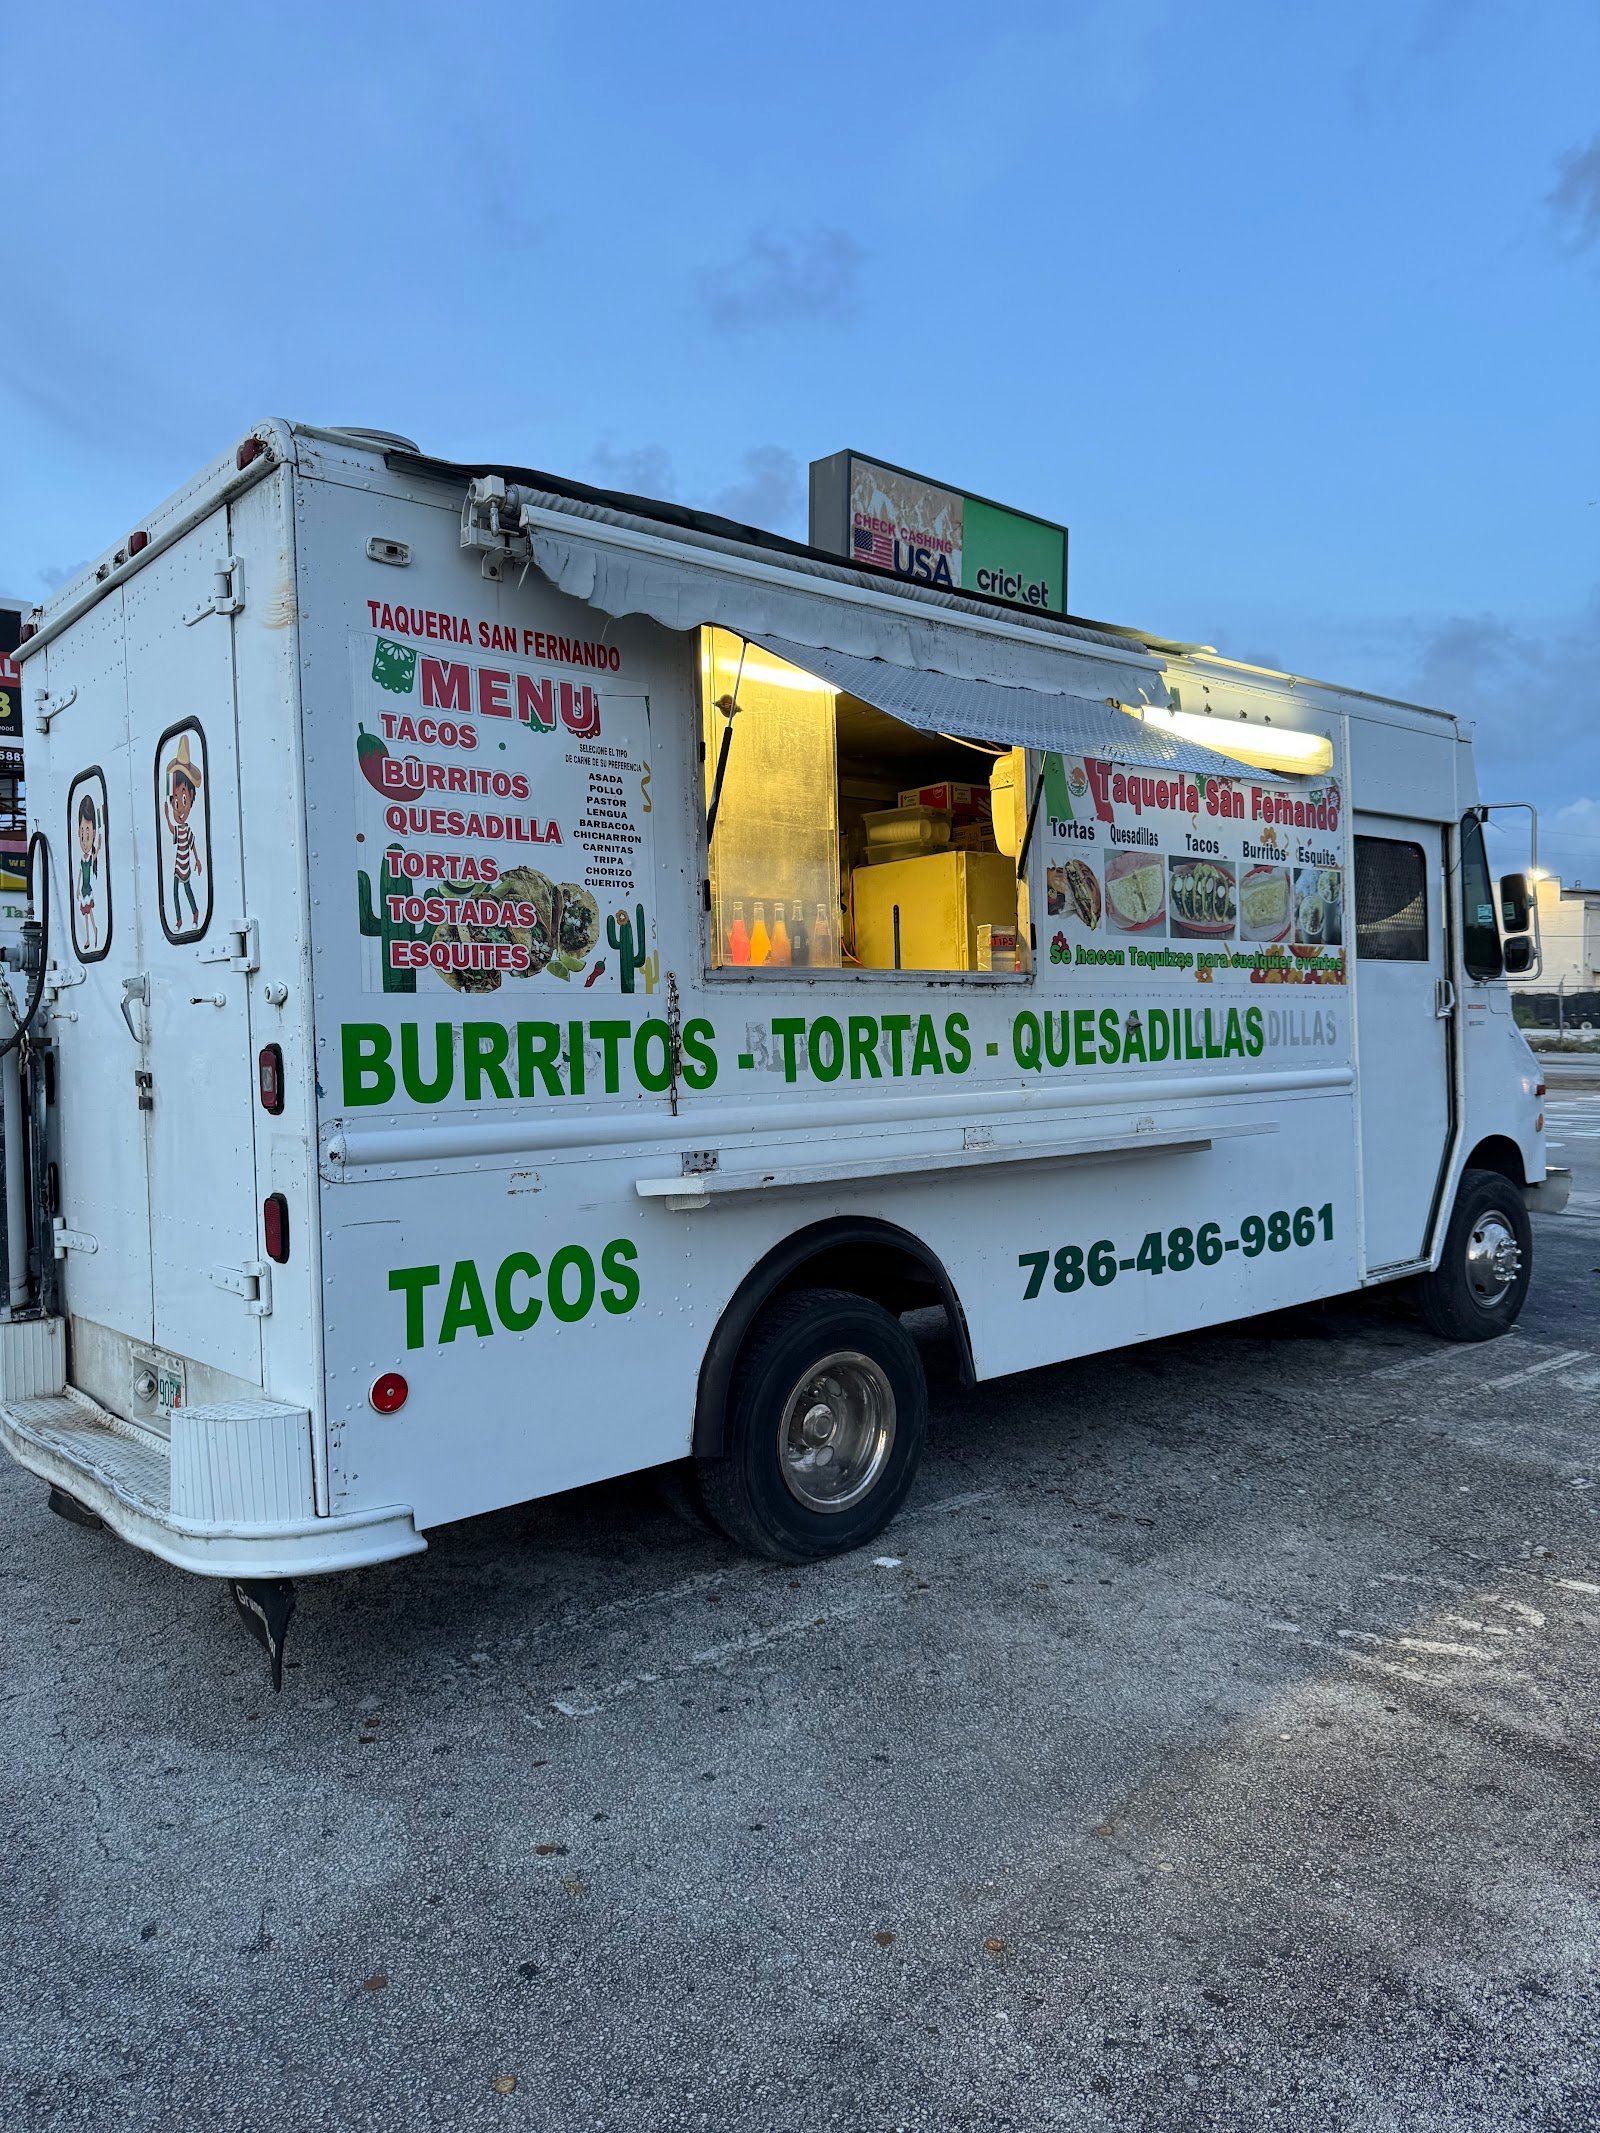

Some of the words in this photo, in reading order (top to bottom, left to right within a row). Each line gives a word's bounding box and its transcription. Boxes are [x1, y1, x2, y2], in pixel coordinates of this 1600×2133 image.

[854, 512, 896, 537] CHECK
[900, 527, 953, 553] CASHING
[893, 540, 953, 587] USA
[977, 568, 1049, 608] cricket
[367, 600, 473, 644] TAQUERIA
[478, 623, 516, 652] SAN
[523, 631, 621, 671] FERNANDO
[420, 658, 594, 731] MENU
[380, 713, 478, 749] TACOS
[565, 754, 573, 763] DE
[573, 755, 592, 766] CARNE
[608, 759, 642, 772] PREFERENCIA
[608, 748, 615, 757] EL
[615, 748, 628, 759] TIPO
[383, 759, 529, 799] BURRITOS
[588, 773, 623, 784] ASADA
[589, 784, 623, 796] POLLO
[586, 796, 627, 808] PASTOR
[586, 808, 628, 819] LENGUA
[1206, 779, 1245, 820] San
[1251, 786, 1338, 832] Fernando
[385, 805, 563, 845] QUESADILLA
[573, 830, 642, 844] CHICHARRON
[579, 819, 636, 832] BARBACOA
[582, 843, 634, 855] CARNITAS
[1050, 817, 1095, 841] Tortas
[1110, 823, 1159, 847] Quesadillas
[1185, 833, 1219, 854] Tacos
[1242, 841, 1286, 862] Burritos
[1298, 846, 1336, 868] Esquite
[386, 851, 499, 882] TORTAS
[585, 867, 632, 878] CHORIZO
[593, 855, 624, 865] TRIPA
[584, 878, 635, 889] CUERITOS
[388, 896, 536, 928] TOSTADAS
[391, 943, 530, 971] ESQUITES
[1050, 944, 1071, 965] Se
[1076, 945, 1124, 966] hacen
[1129, 947, 1194, 970] Taquizas
[1197, 952, 1227, 971] para
[1231, 951, 1292, 973] cualquier
[1295, 954, 1343, 971] eventos
[340, 1018, 718, 1107] BURRITOS
[771, 1012, 972, 1083] TORTAS
[1012, 1007, 1264, 1073] QUESADILLAS
[1018, 1202, 1335, 1300] 786-486-9861
[388, 1237, 640, 1349] TACOS
